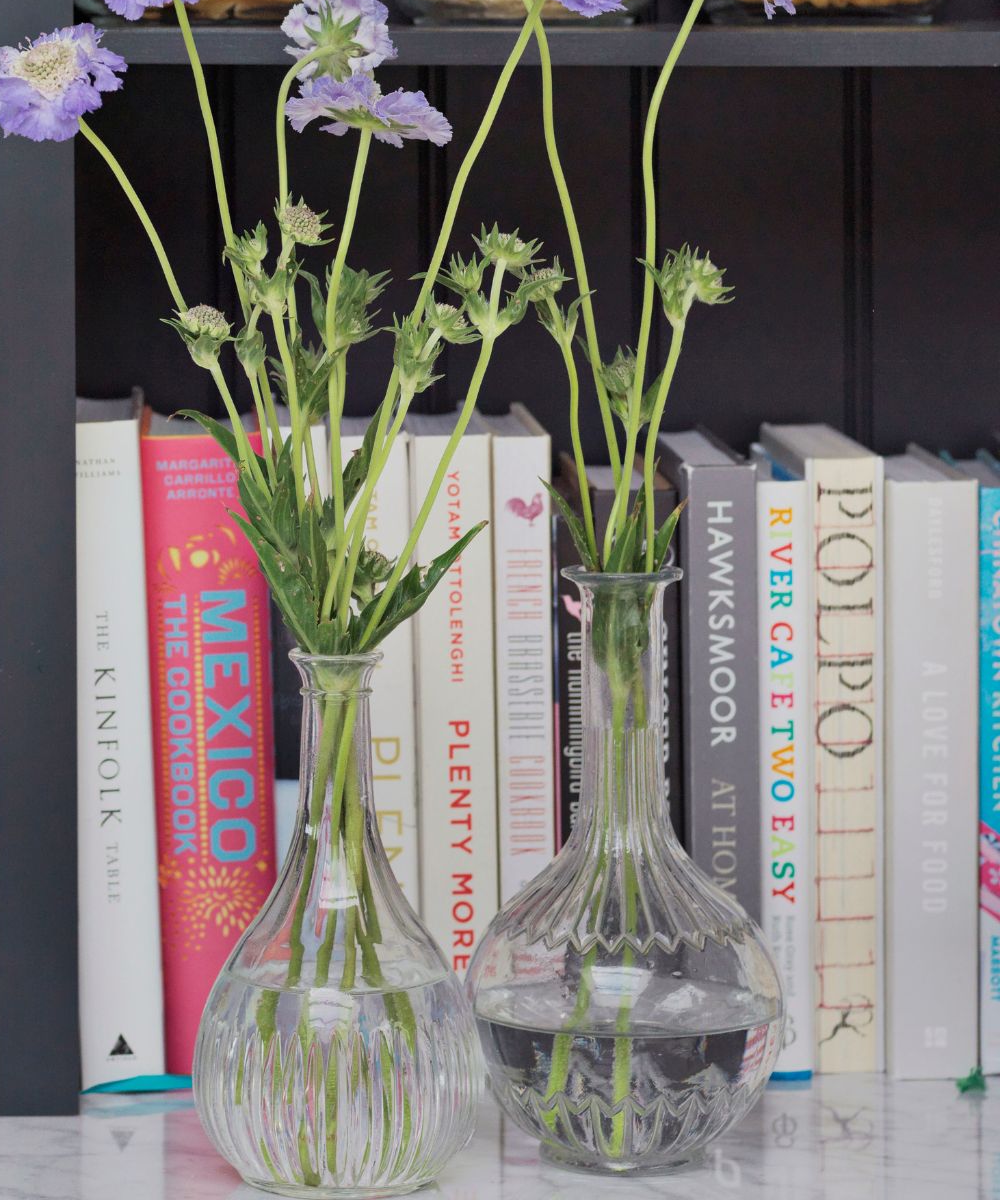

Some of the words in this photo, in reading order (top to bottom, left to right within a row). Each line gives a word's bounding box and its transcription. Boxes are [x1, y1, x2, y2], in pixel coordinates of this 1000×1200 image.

[155, 458, 234, 472] MARGARIT
[163, 472, 236, 487] CARRILLO
[166, 486, 235, 500] ARRONTE
[446, 470, 461, 540] YOTAM
[506, 549, 544, 620] FRENCH
[769, 507, 794, 611] RIVER
[95, 611, 110, 651] THE
[163, 593, 189, 658] THE
[706, 500, 738, 748] HAWKSMOOR
[815, 481, 874, 758] POLPO
[507, 634, 545, 740] BRASSERIE
[770, 622, 795, 709] CAFE
[921, 660, 948, 676] A
[94, 667, 122, 828] KINFOLK
[166, 666, 198, 855] COOKBOOK
[199, 589, 257, 863] MEXICO
[771, 720, 795, 803] TWO
[921, 691, 949, 759] LOVE
[448, 720, 473, 855] PLENTY
[508, 755, 546, 856] COOKBOOK
[711, 778, 737, 817] AT
[921, 773, 948, 826] FOR
[105, 842, 121, 904] TABLE
[771, 815, 796, 904] EASY
[921, 840, 948, 913] FOOD
[451, 873, 474, 972] MORE
